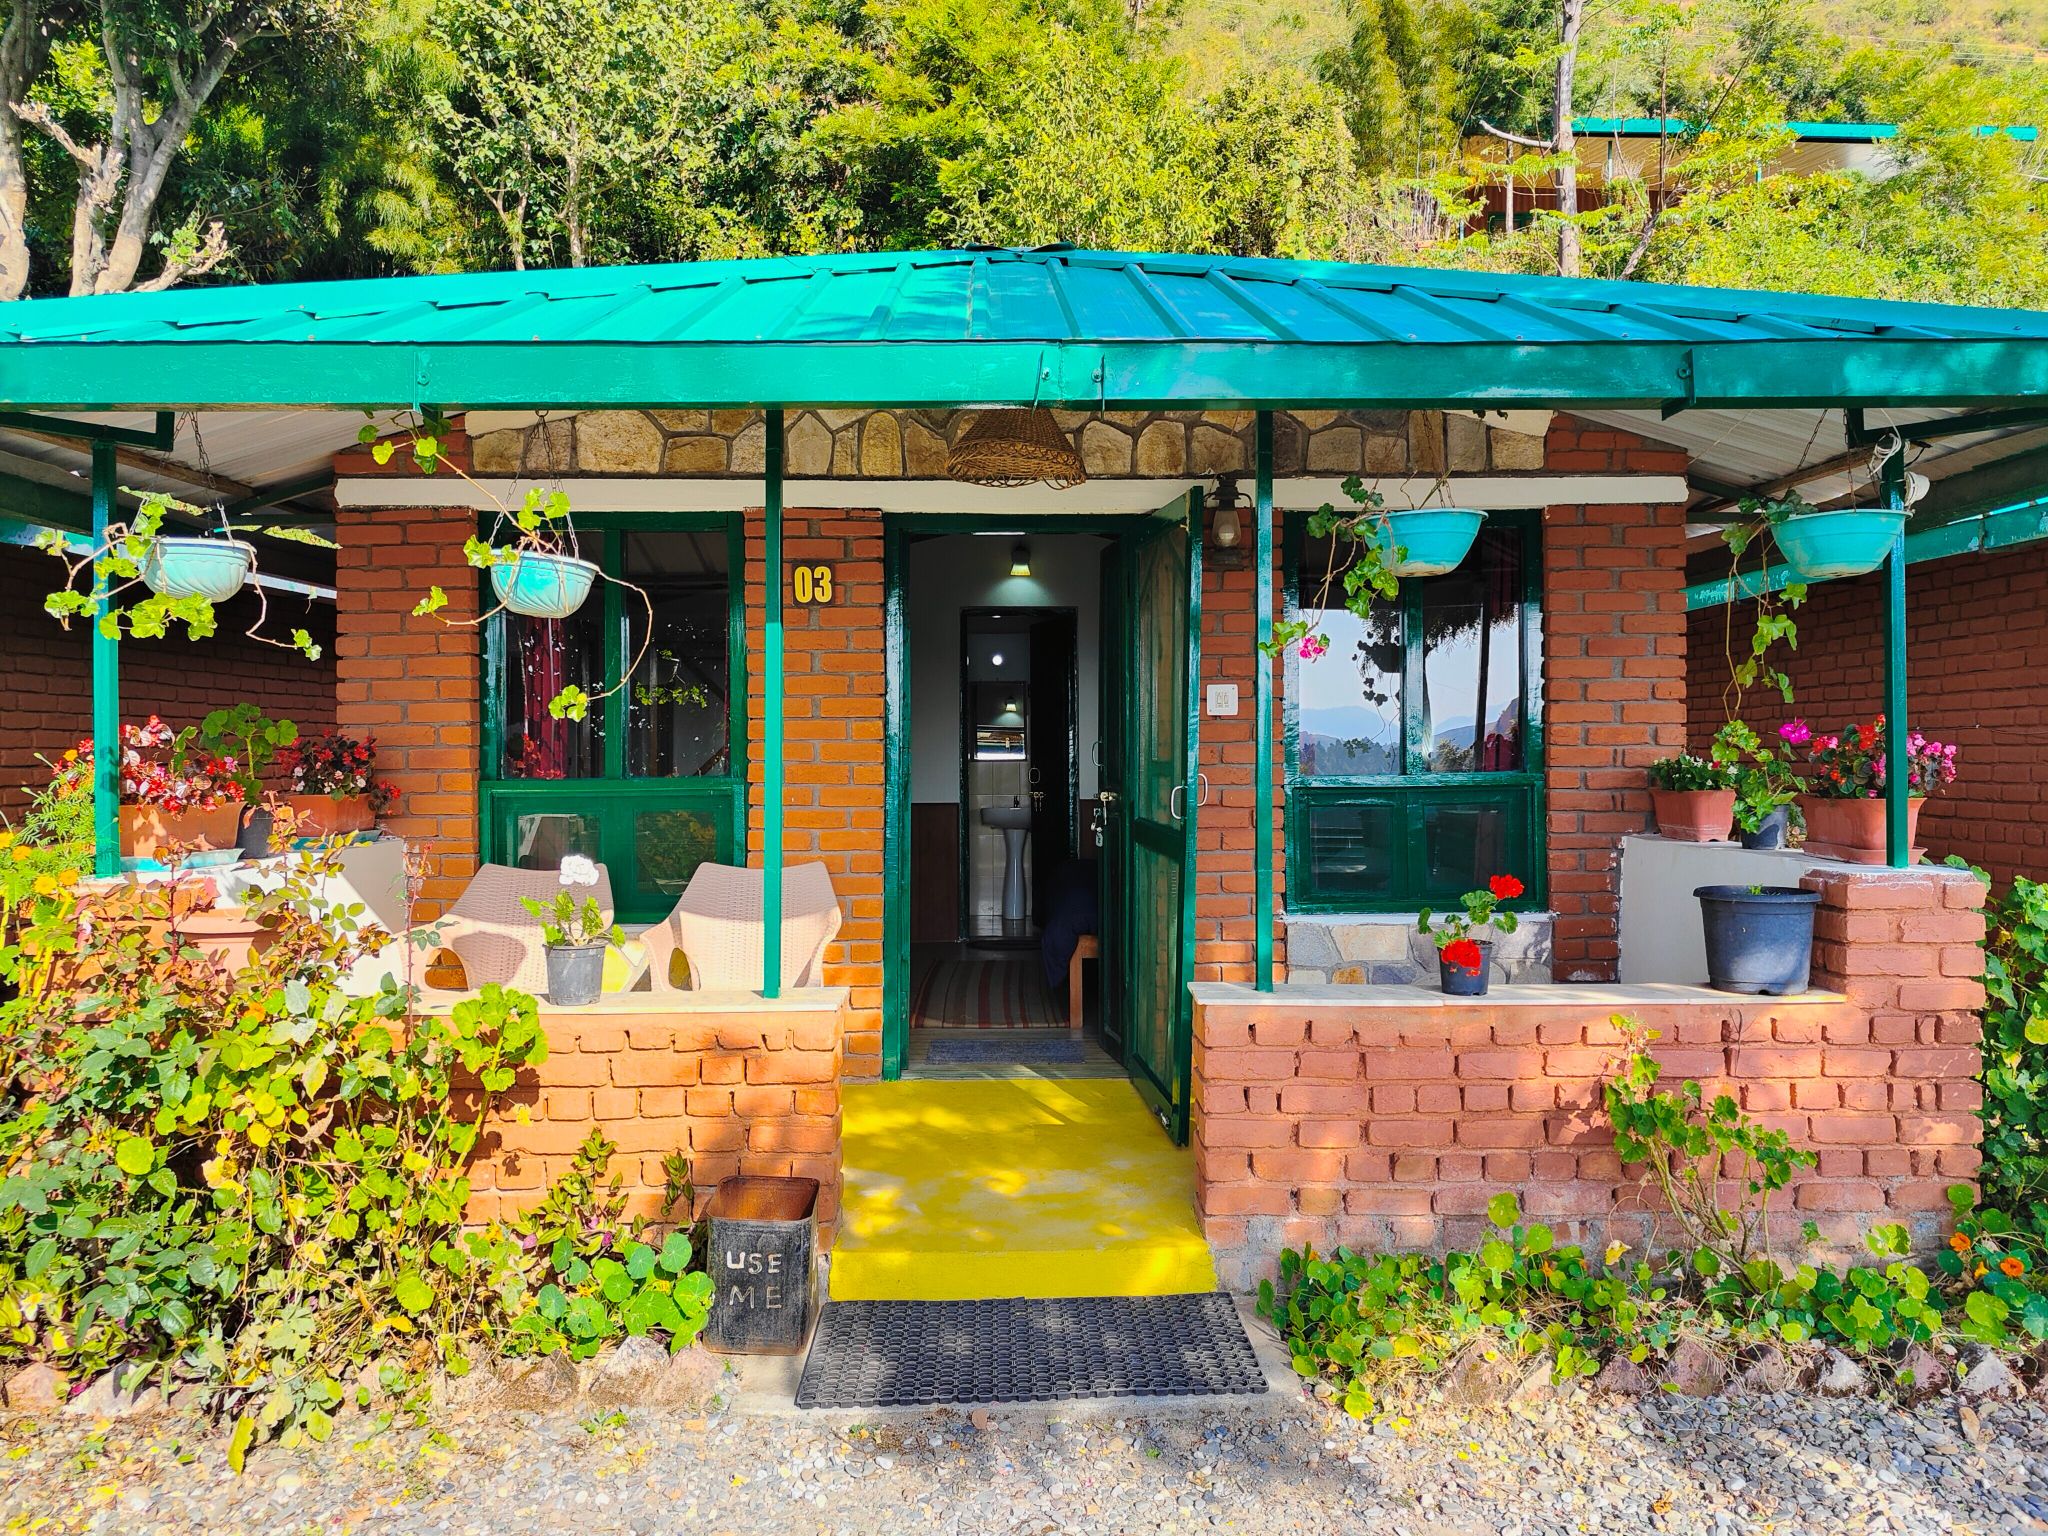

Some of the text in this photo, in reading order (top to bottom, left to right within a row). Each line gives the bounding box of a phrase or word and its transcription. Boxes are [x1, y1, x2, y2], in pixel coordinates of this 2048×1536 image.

[794, 566, 832, 604] 03
[726, 1250, 782, 1275] USE
[728, 1284, 783, 1310] ME
